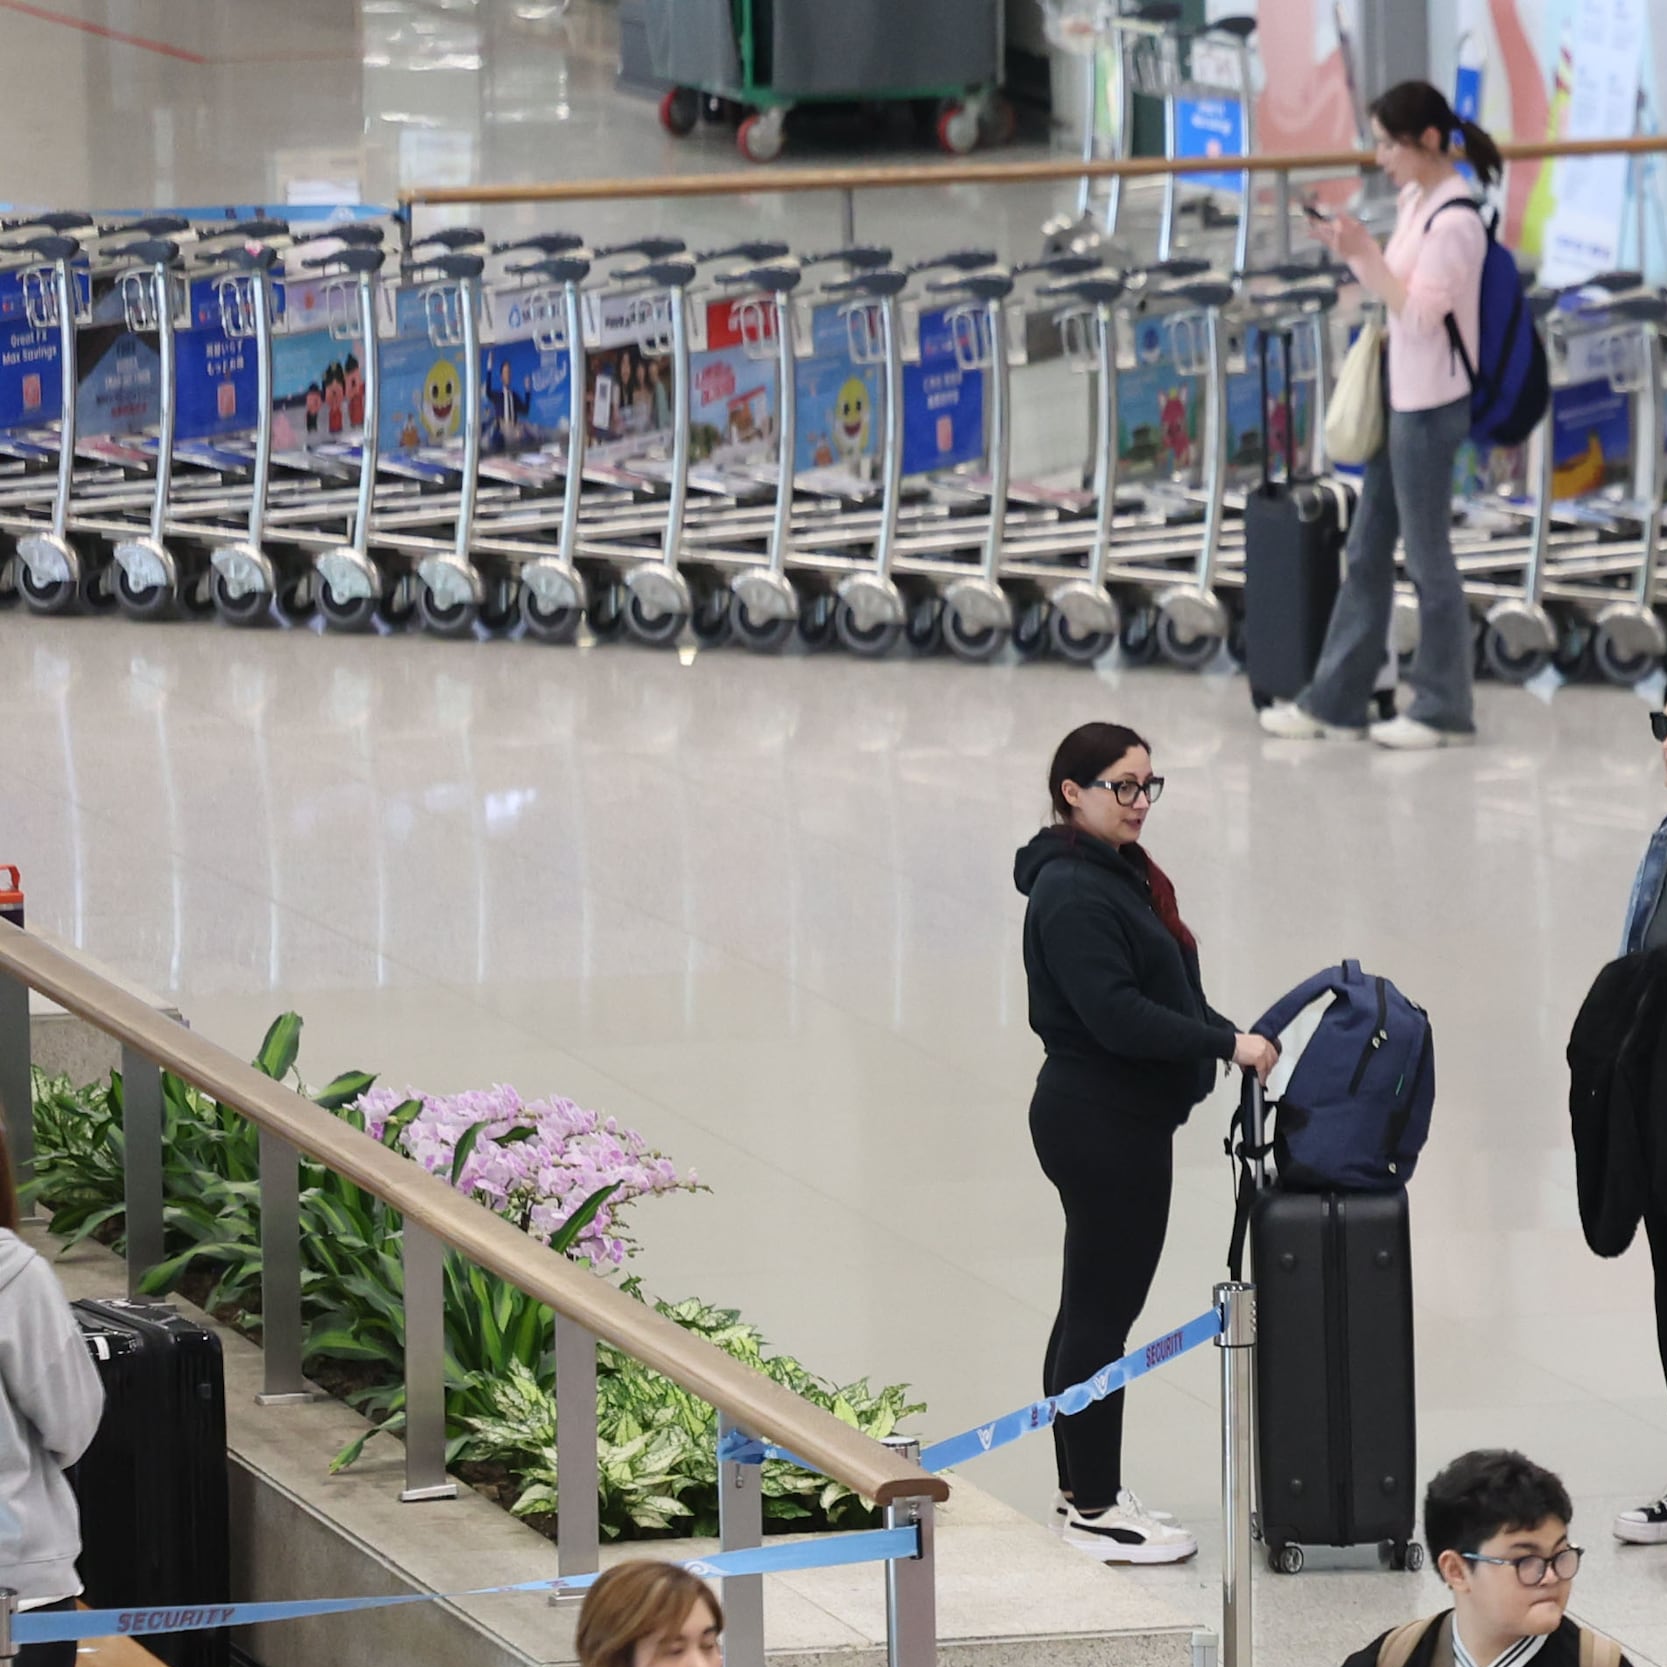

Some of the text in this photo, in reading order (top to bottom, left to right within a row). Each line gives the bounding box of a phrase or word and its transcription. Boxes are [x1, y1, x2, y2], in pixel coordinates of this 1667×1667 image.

[2, 345, 57, 366] Max Savings
[1145, 1331, 1185, 1367] SECURITY
[117, 1607, 235, 1632] SECURITY
